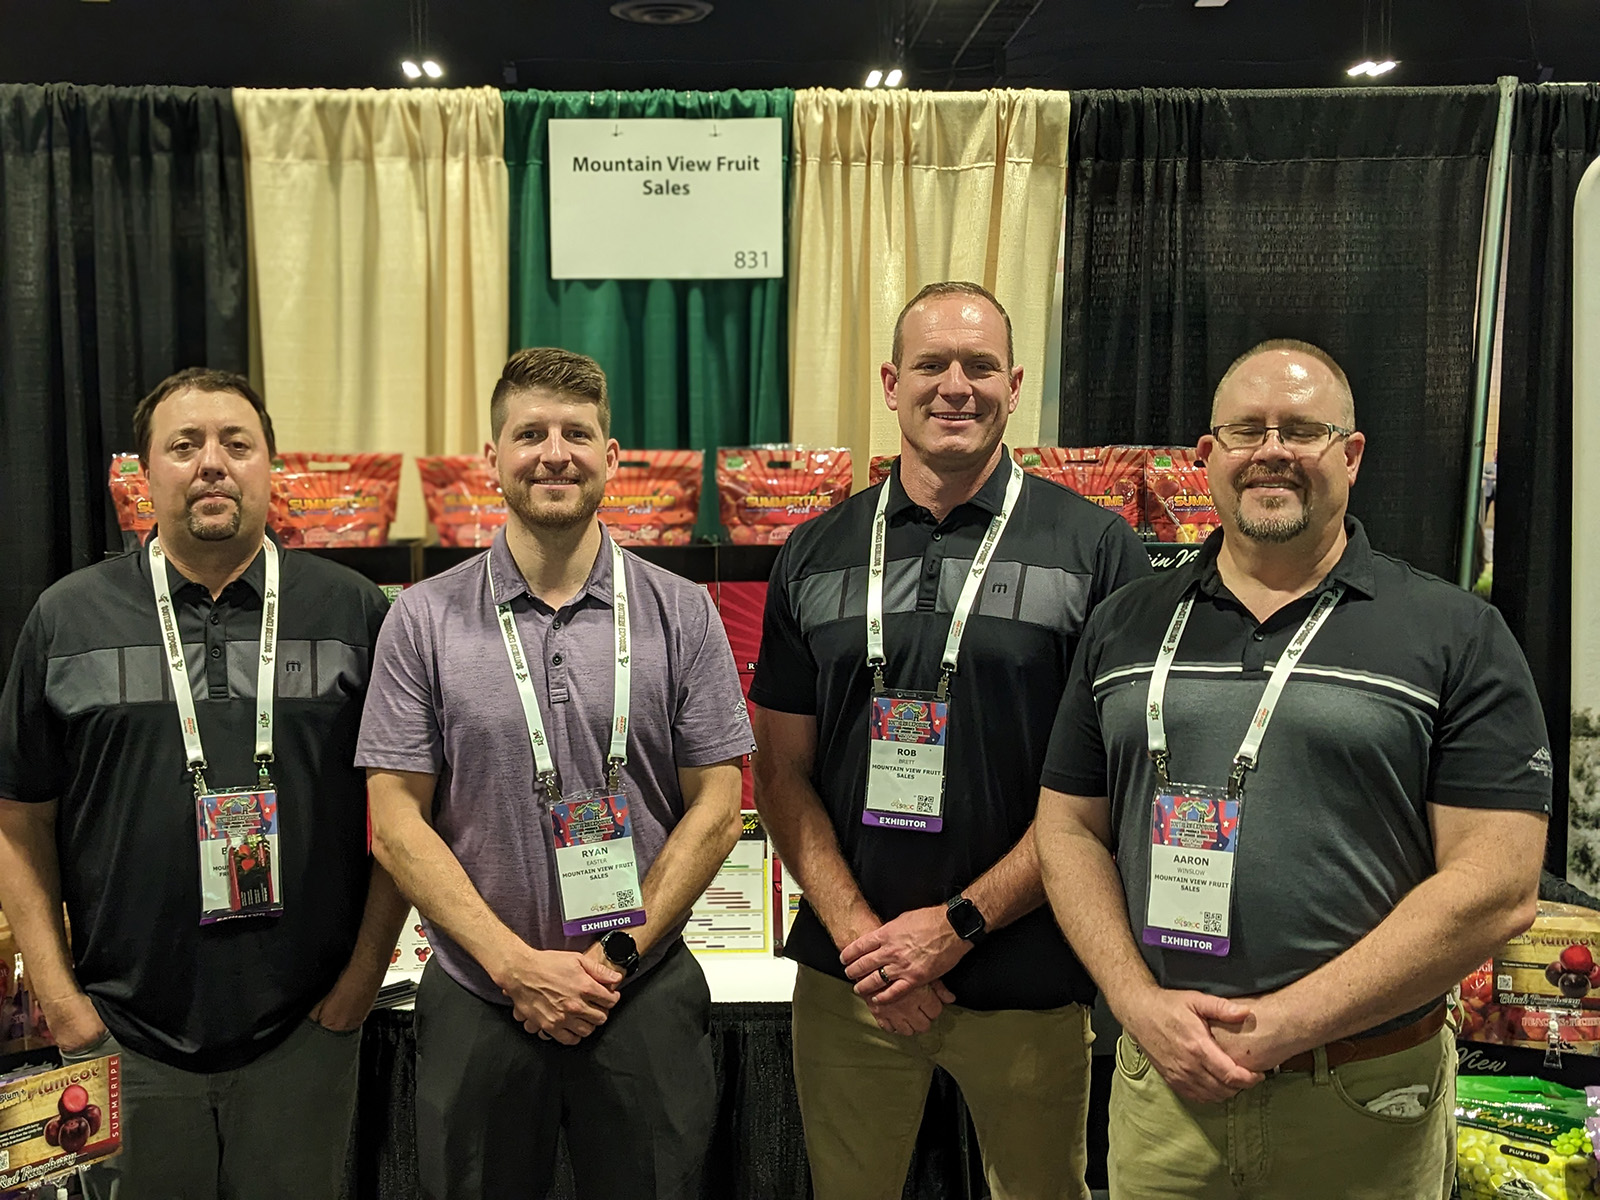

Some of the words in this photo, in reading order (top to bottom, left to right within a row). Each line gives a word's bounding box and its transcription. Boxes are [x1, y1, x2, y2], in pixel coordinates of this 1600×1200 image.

[573, 156, 662, 172] Mountain
[667, 156, 711, 172] View
[716, 156, 760, 172] Fruit
[643, 179, 690, 195] Sales
[734, 250, 769, 269] 831
[897, 748, 917, 757] ROB
[872, 764, 904, 773] MOUNTAIN
[879, 816, 927, 828] EXHIBITOR
[581, 846, 608, 858] RYAN
[586, 858, 607, 866] EASTER
[1173, 855, 1210, 866] AARON
[562, 868, 596, 879] MOUNTAIN
[598, 865, 614, 873] VIEW
[615, 861, 634, 870] FRUIT
[589, 873, 609, 881] SALES
[1177, 867, 1206, 876] WINSLOW
[1154, 874, 1189, 884] MOUNTAIN
[1189, 878, 1207, 886] VIEW
[1208, 881, 1229, 889] FRUIT
[1180, 885, 1200, 893] SALES
[581, 917, 631, 932] EXHIBITOR
[1161, 935, 1213, 951] EXHIBITOR
[1457, 1046, 1507, 1073] View
[27, 1066, 100, 1101] Plumcot
[110, 1059, 119, 1138] SUMMERIPE
